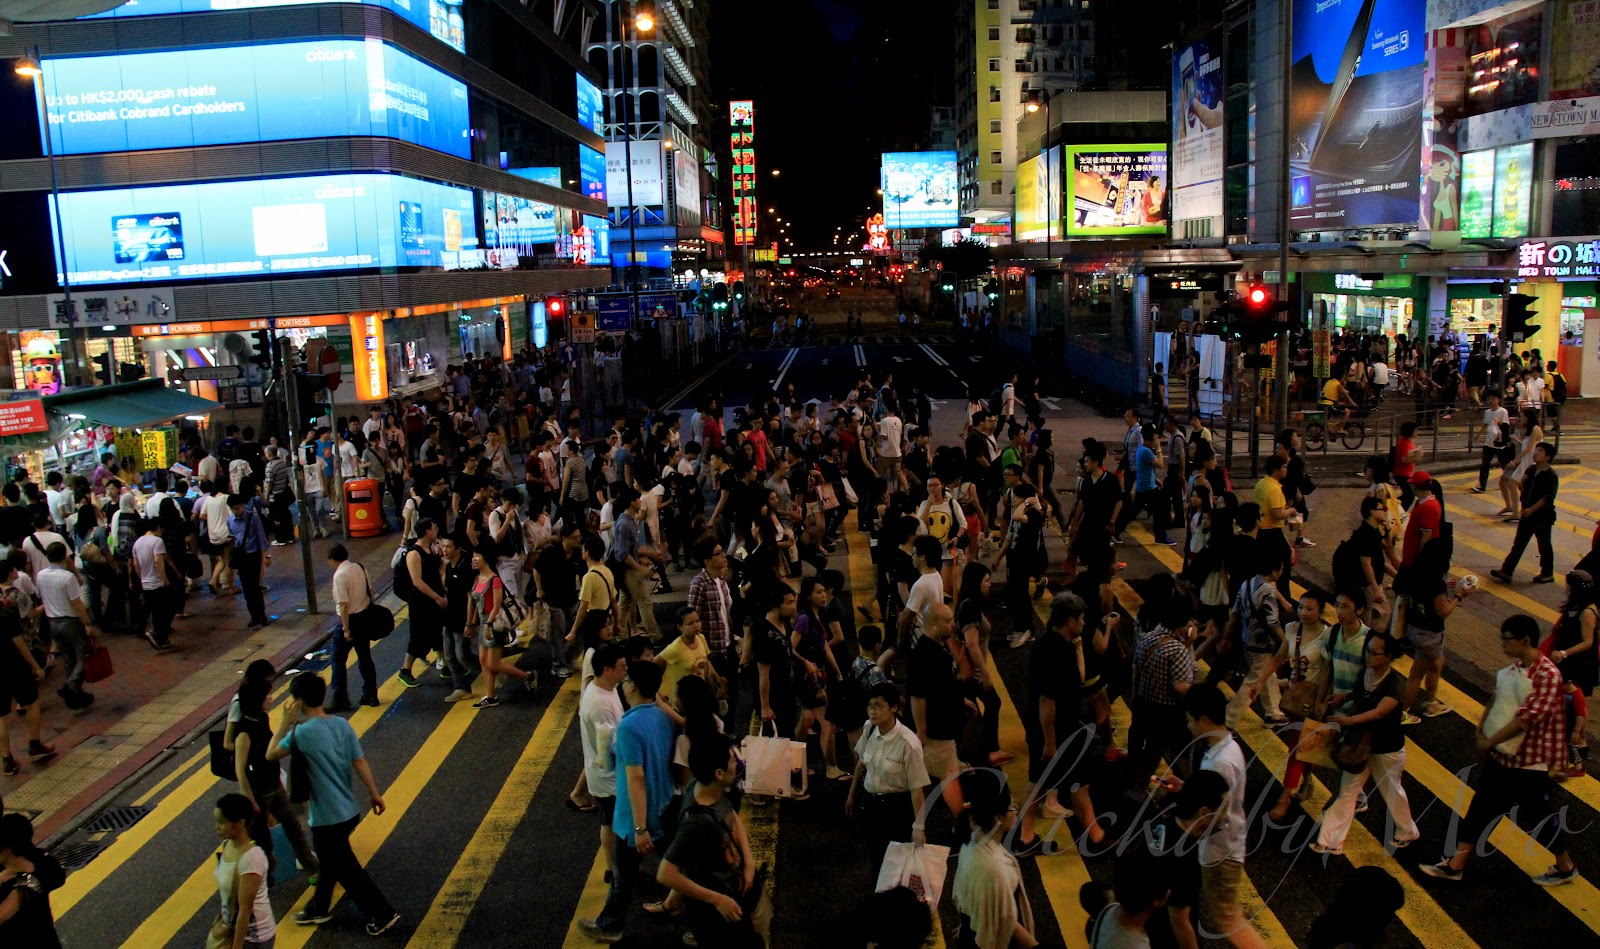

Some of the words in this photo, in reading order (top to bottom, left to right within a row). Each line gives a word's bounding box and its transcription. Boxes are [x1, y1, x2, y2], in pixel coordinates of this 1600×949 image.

[1384, 44, 1399, 56] SERIES
[1400, 30, 1408, 51] 9
[306, 47, 357, 62] citibank
[66, 94, 78, 106] to
[81, 89, 144, 106] HK$2,000
[146, 88, 174, 99] cash
[177, 84, 216, 98] rebate
[48, 112, 65, 124] for
[68, 107, 118, 123] Citibank
[120, 106, 170, 120] Cobrand
[172, 102, 246, 116] Cardholders
[1531, 113, 1550, 126] NEW
[1556, 110, 1585, 124] TOWN
[315, 184, 366, 199] citibank
[1544, 266, 1570, 275] TOWN
[170, 324, 202, 333] FORTRESS
[278, 318, 310, 326] FORTRESS
[368, 352, 382, 396] FORTRESS
